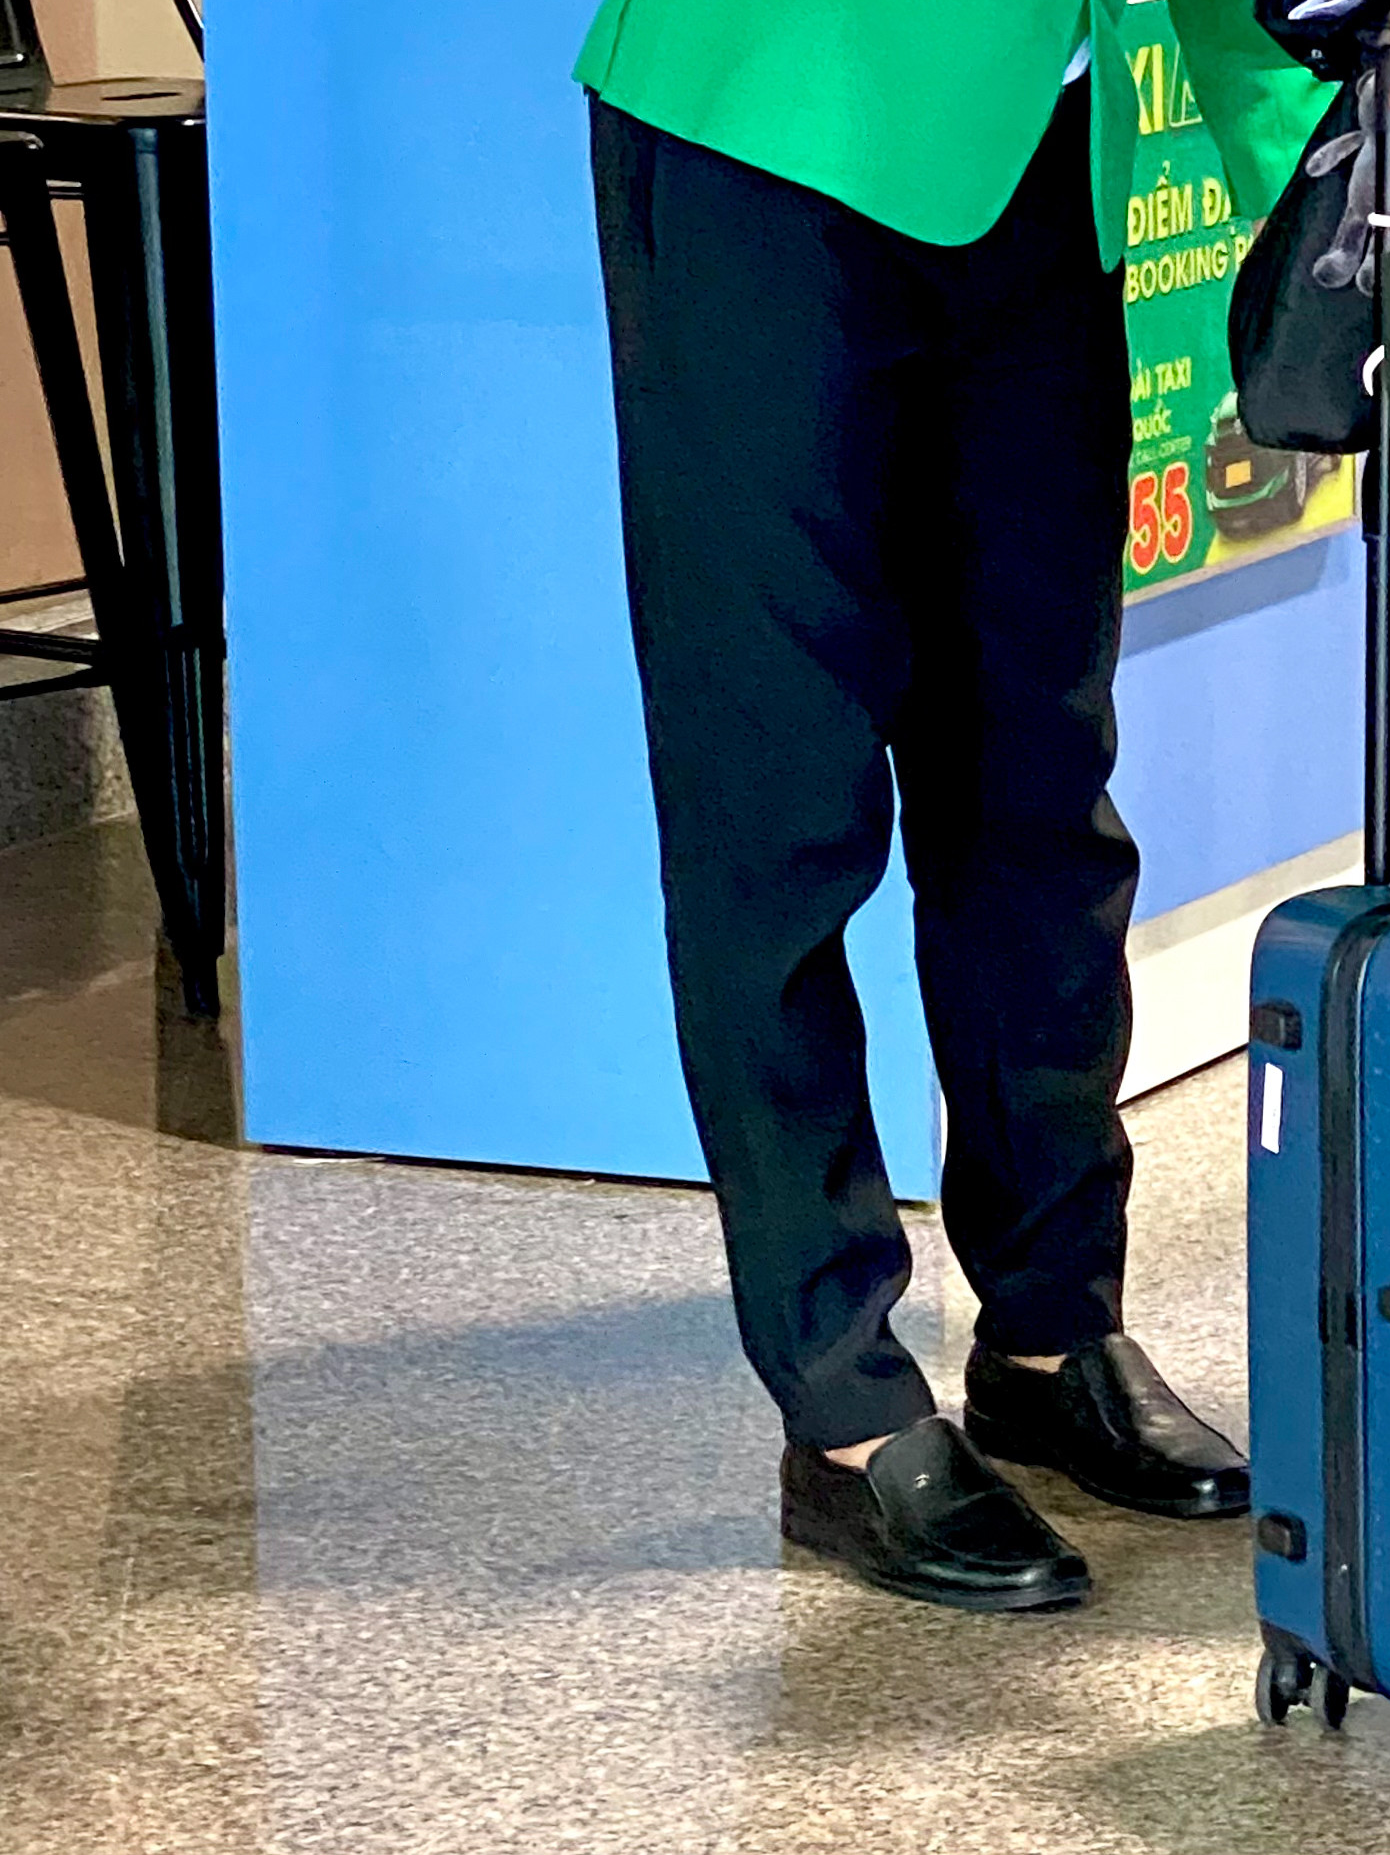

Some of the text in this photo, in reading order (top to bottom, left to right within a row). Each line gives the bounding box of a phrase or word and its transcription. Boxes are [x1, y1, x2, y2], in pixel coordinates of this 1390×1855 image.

[1128, 160, 1193, 247] ĐIỂM
[1125, 241, 1229, 304] BOOKING
[1155, 356, 1191, 395] TAXI
